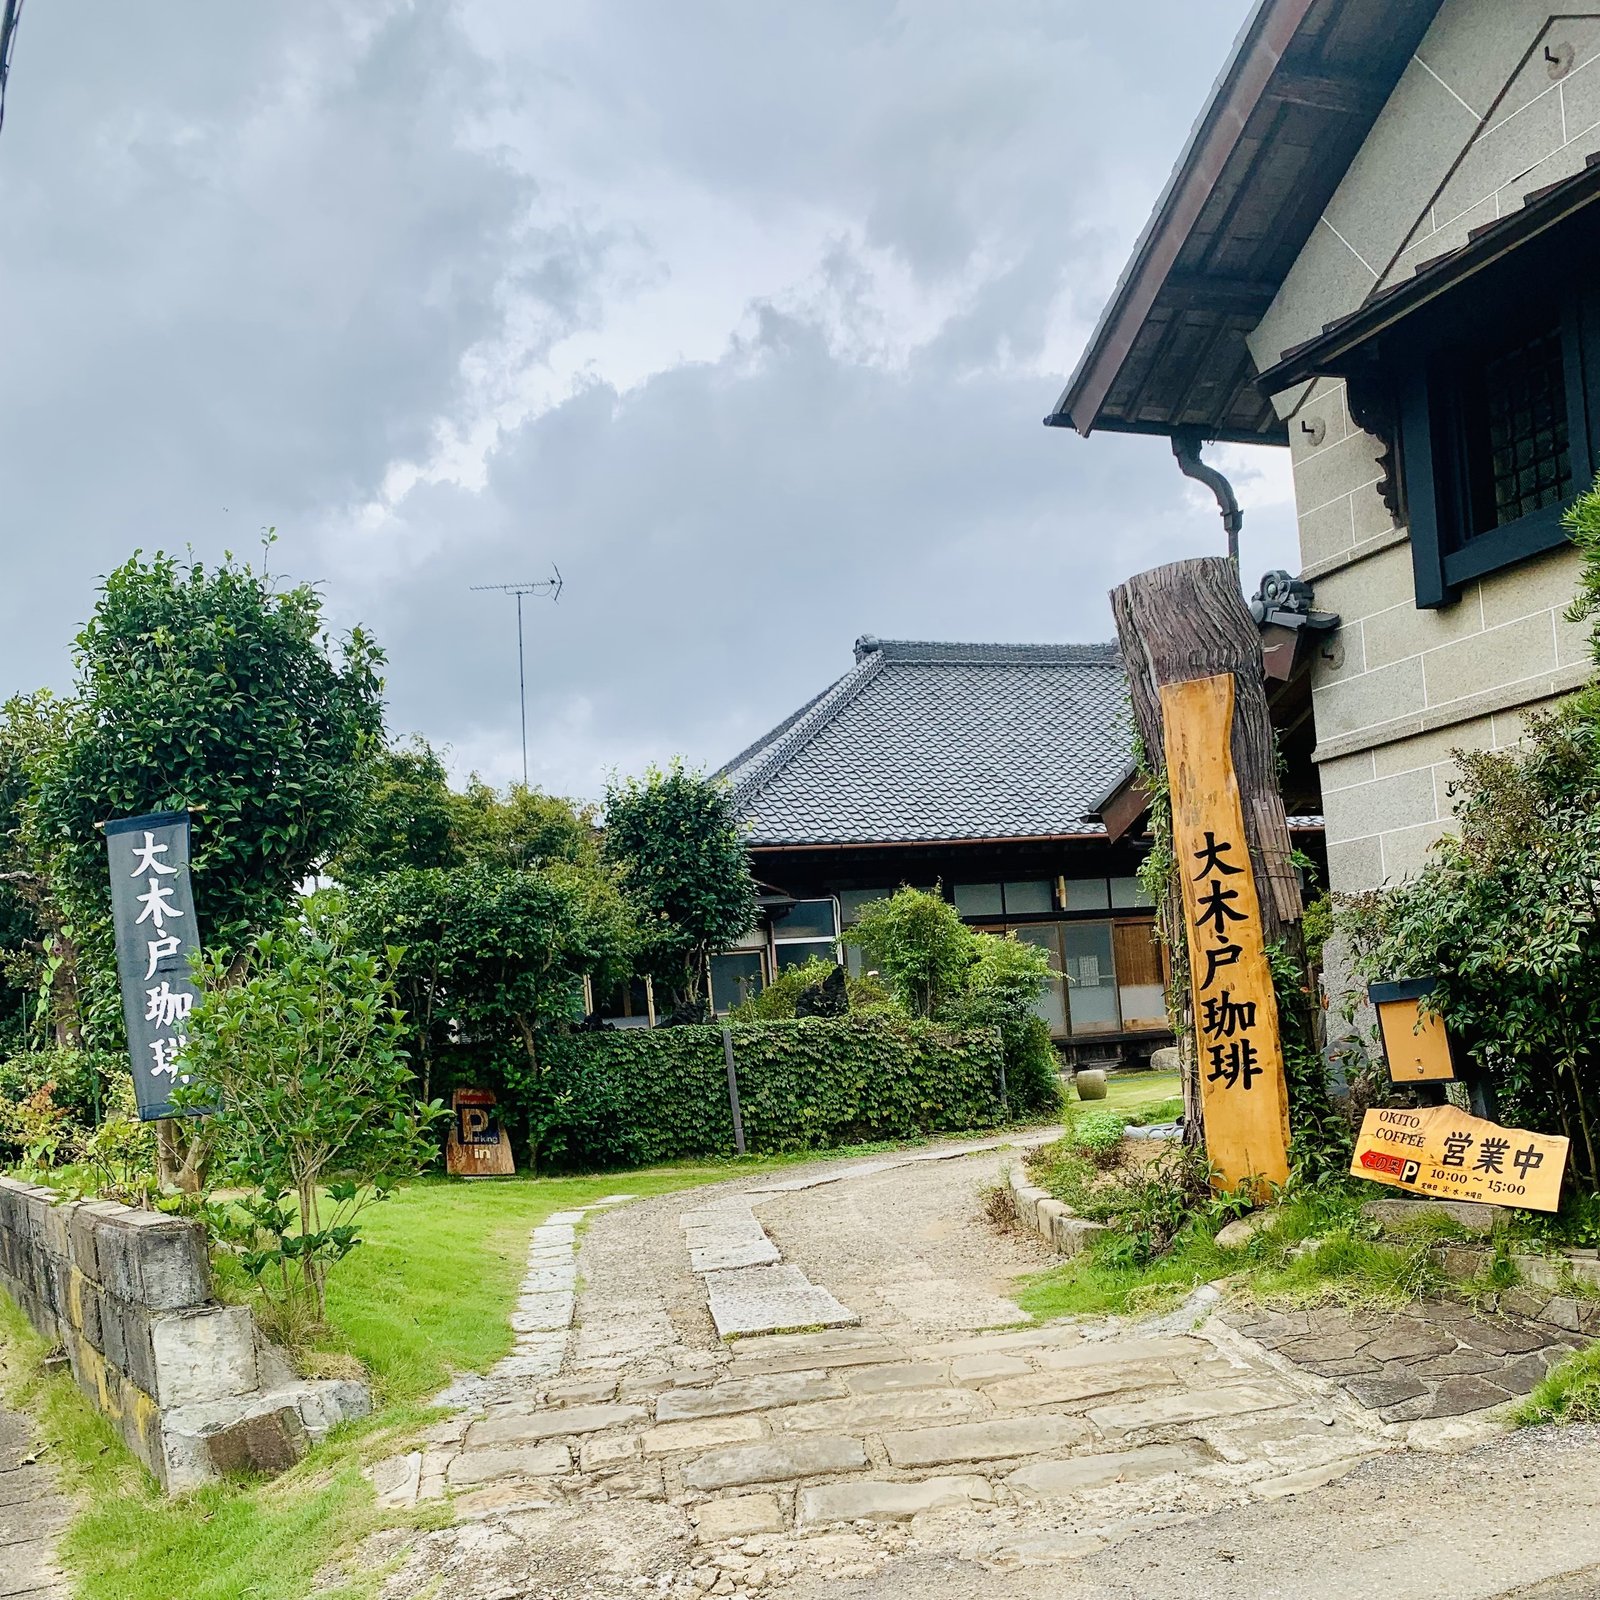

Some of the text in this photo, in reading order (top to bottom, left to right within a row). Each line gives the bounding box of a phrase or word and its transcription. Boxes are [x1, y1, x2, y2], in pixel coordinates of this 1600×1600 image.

[1193, 832, 1264, 1091] 大木戸珈琲
[1379, 1110, 1420, 1129] OKITO
[1375, 1127, 1426, 1148] COFFEE
[474, 1148, 490, 1159] in
[1442, 1131, 1544, 1180] 営業中
[1365, 1154, 1418, 1182] この奥 P
[1420, 1182, 1438, 1191] 定休日
[1430, 1169, 1468, 1184] 10:00
[1487, 1179, 1526, 1196] 15:00
